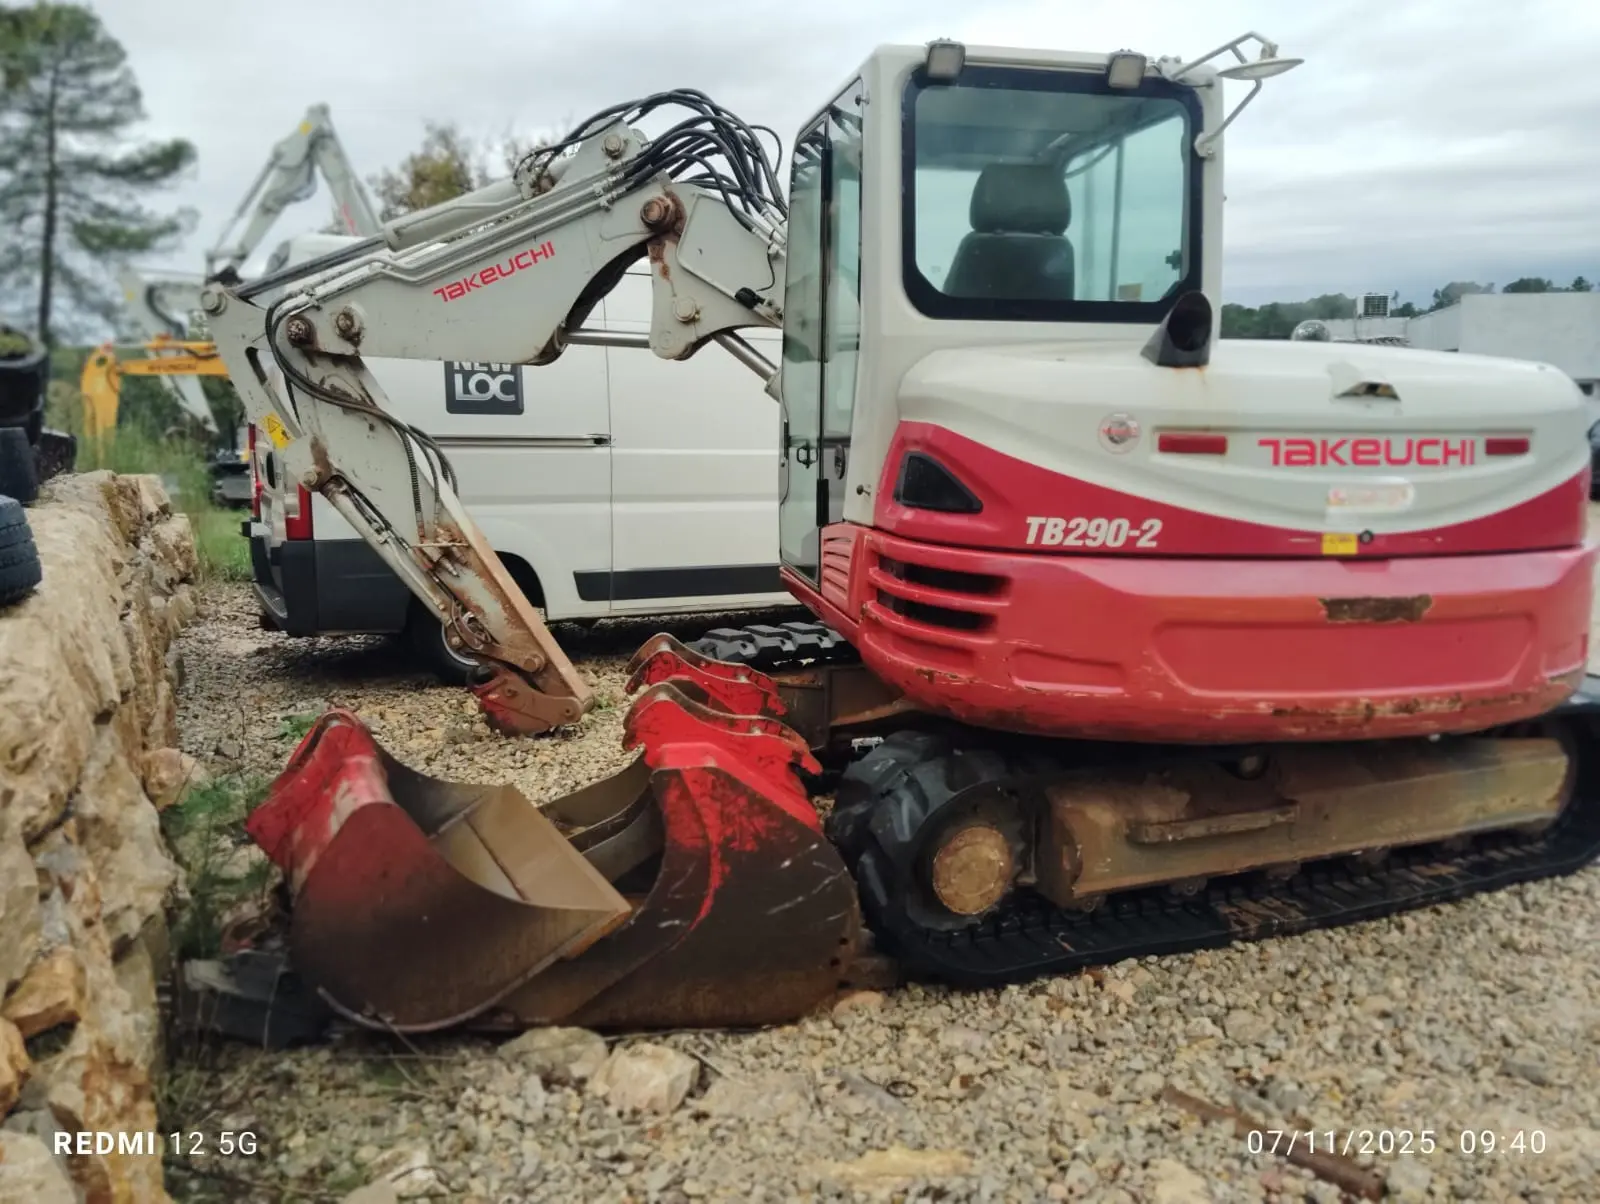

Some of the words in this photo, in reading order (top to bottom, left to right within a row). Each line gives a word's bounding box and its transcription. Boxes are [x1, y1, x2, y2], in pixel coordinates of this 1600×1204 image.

[433, 240, 555, 302] TAKEUCHI
[454, 372, 516, 402] LOC
[1258, 438, 1475, 466] TAKEUCHI
[1025, 516, 1163, 548] TB290-2
